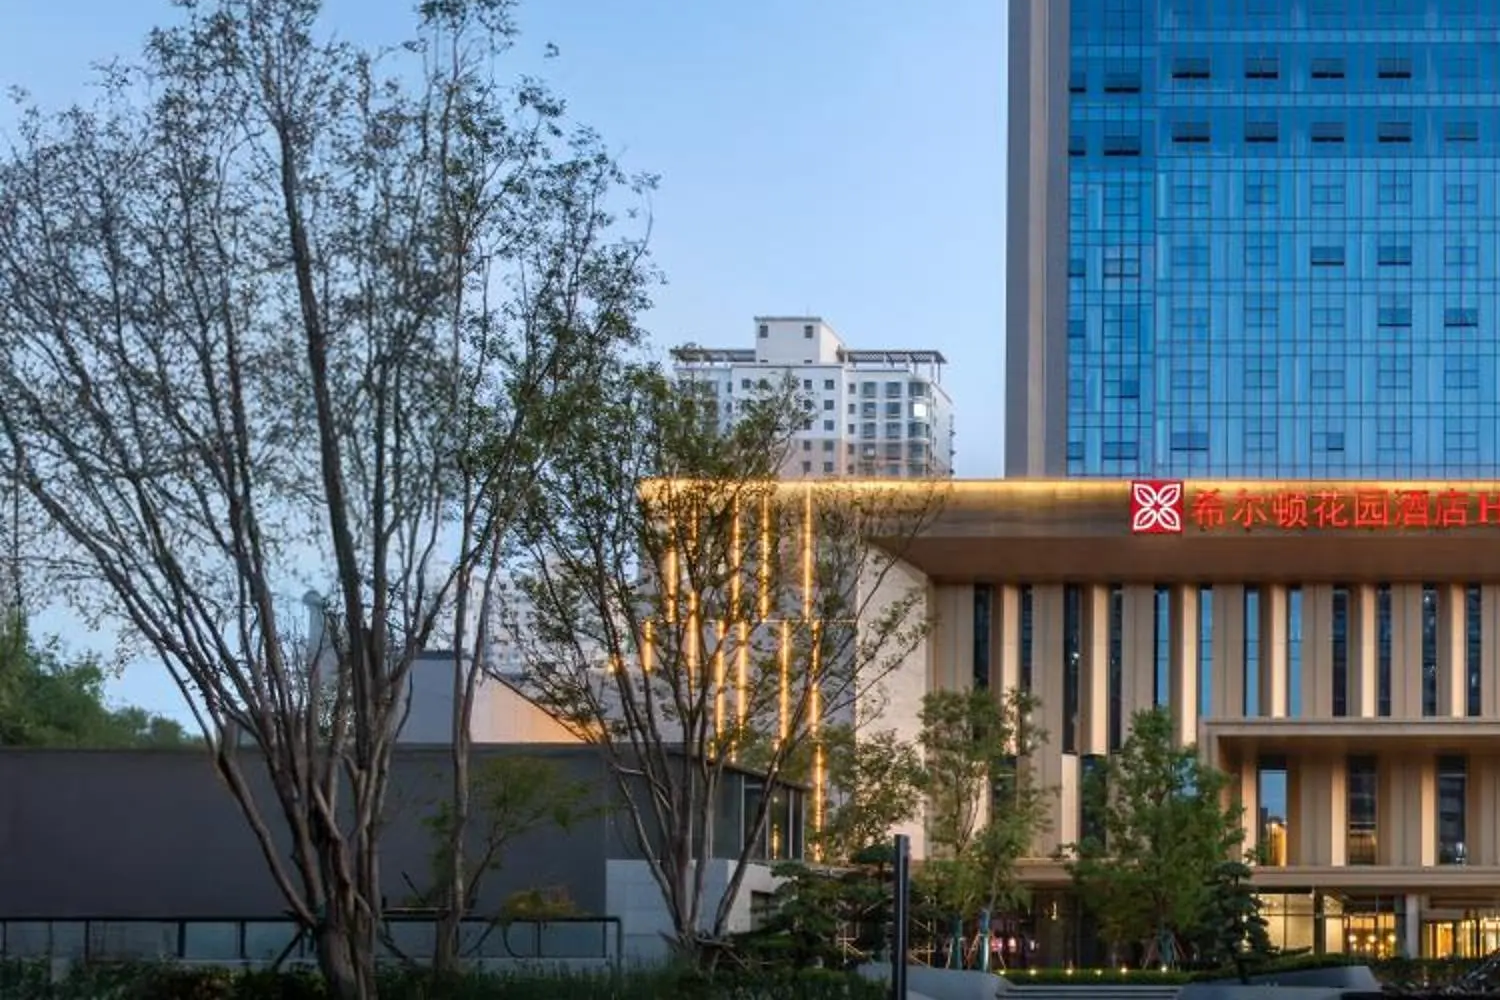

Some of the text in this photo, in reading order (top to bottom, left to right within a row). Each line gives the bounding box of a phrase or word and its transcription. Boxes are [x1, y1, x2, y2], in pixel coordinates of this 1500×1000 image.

[1190, 488, 1468, 527] 希尔顿花园酒店
